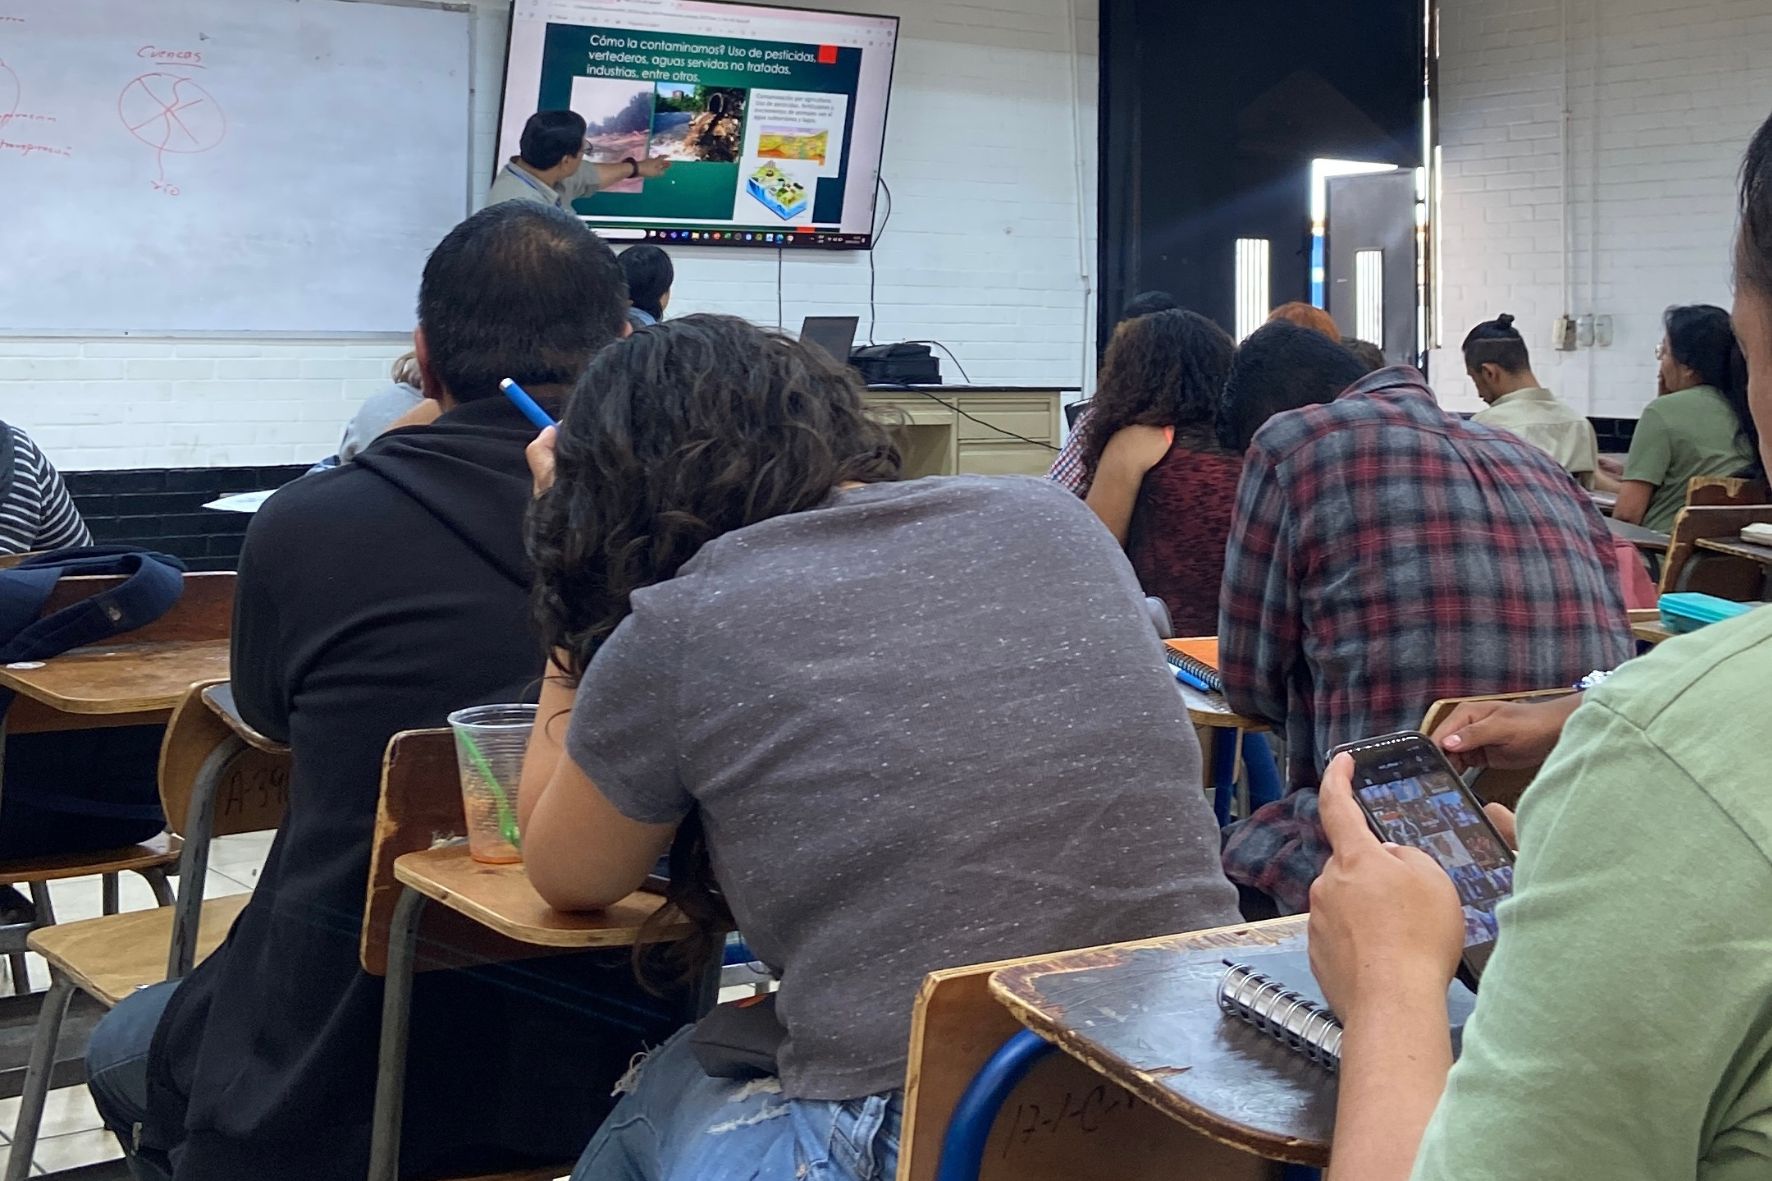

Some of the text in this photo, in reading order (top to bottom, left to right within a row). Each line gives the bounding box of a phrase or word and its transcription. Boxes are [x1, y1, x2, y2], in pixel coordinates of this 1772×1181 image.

[136, 45, 202, 62] Cuencas
[590, 34, 817, 63] Cómo la contaminamos? Uso de pesticidas,
[651, 56, 686, 68] aguas
[687, 58, 729, 70] servidas
[730, 62, 745, 71] no
[641, 69, 670, 80] entre
